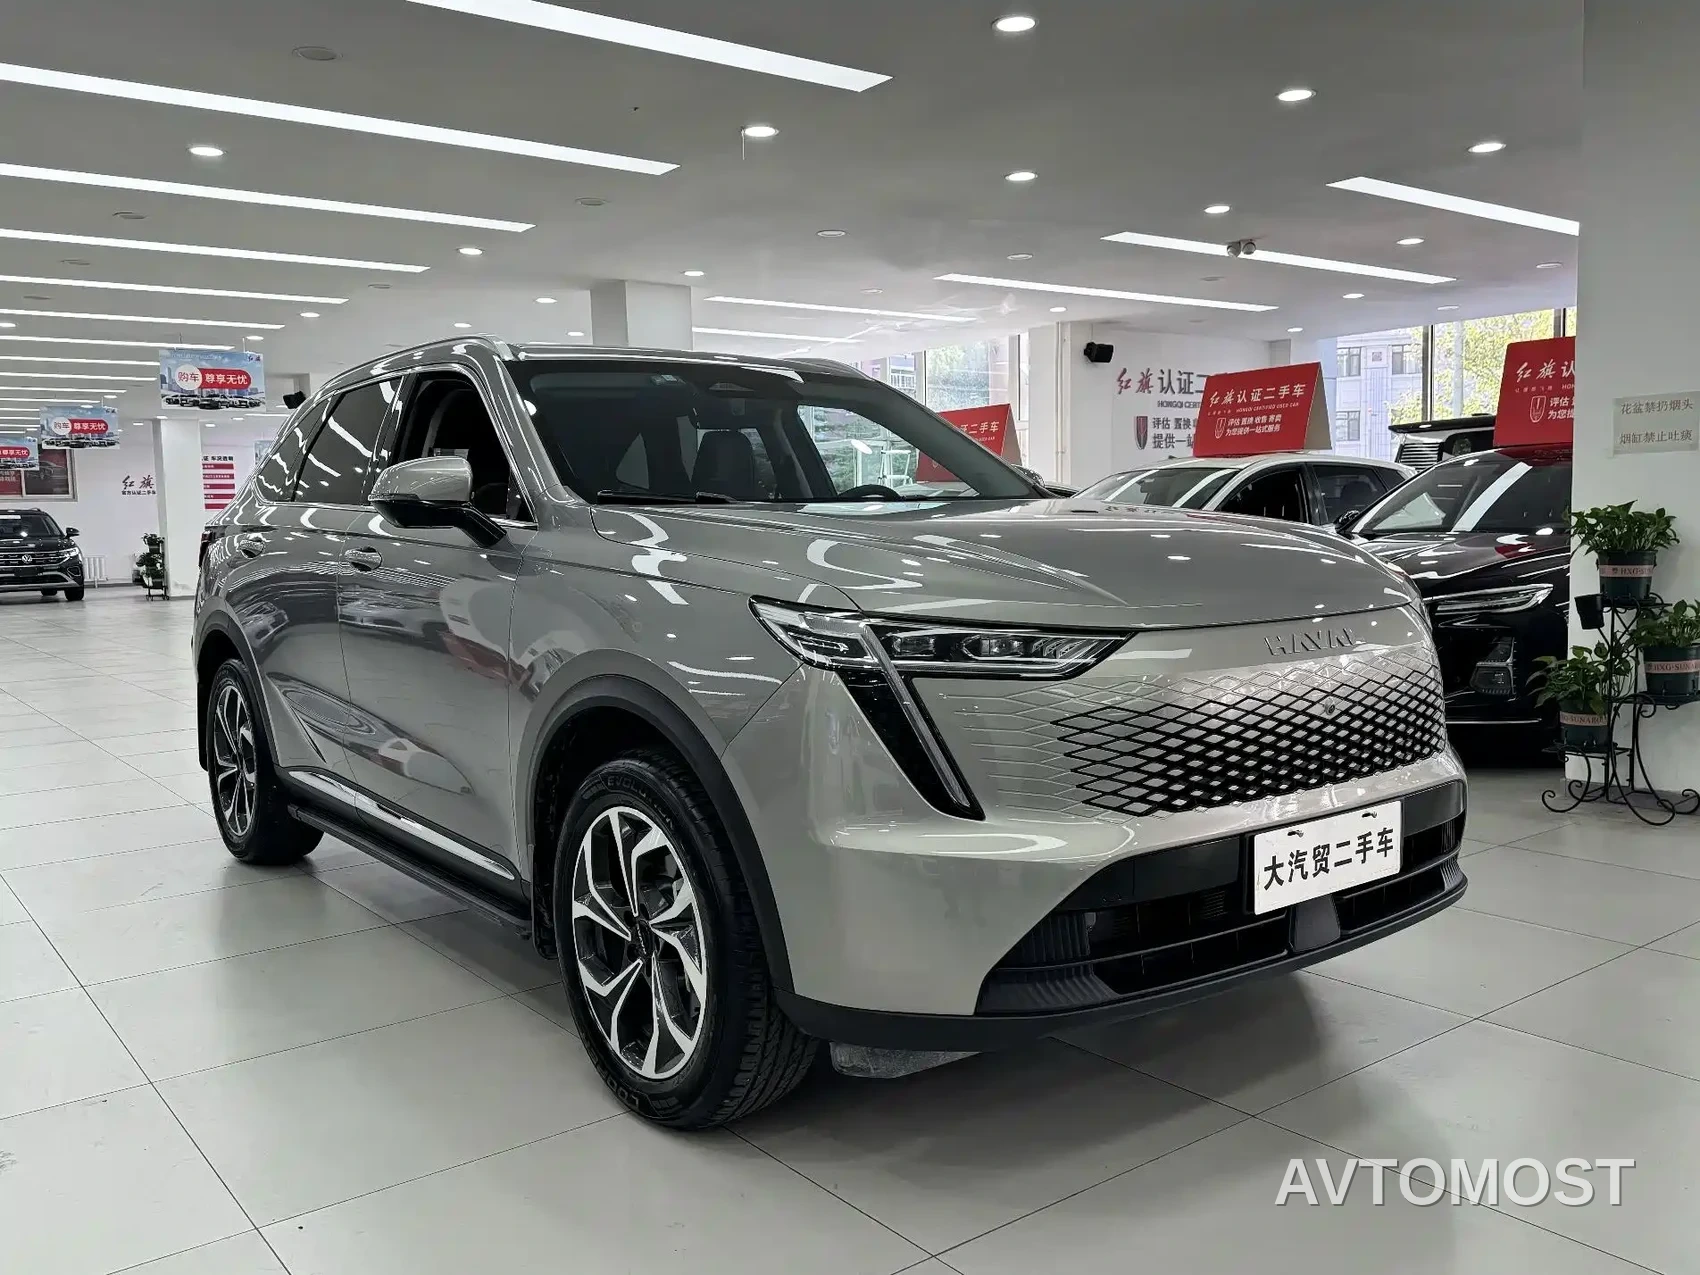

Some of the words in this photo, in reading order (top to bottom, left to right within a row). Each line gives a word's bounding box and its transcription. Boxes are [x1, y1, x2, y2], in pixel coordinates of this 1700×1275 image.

[178, 371, 200, 382] 购车
[205, 373, 248, 385] 尊享无忧
[1209, 383, 1307, 408] 红旗认证二手车
[1549, 396, 1569, 407] 评估
[1620, 398, 1694, 415] 花盆禁扔烟头
[1152, 417, 1171, 430] 评估
[1619, 429, 1693, 446] 烟缸禁止吐痰
[1263, 627, 1366, 656] HAVAL
[1263, 827, 1394, 891] 大汽贸二手车
